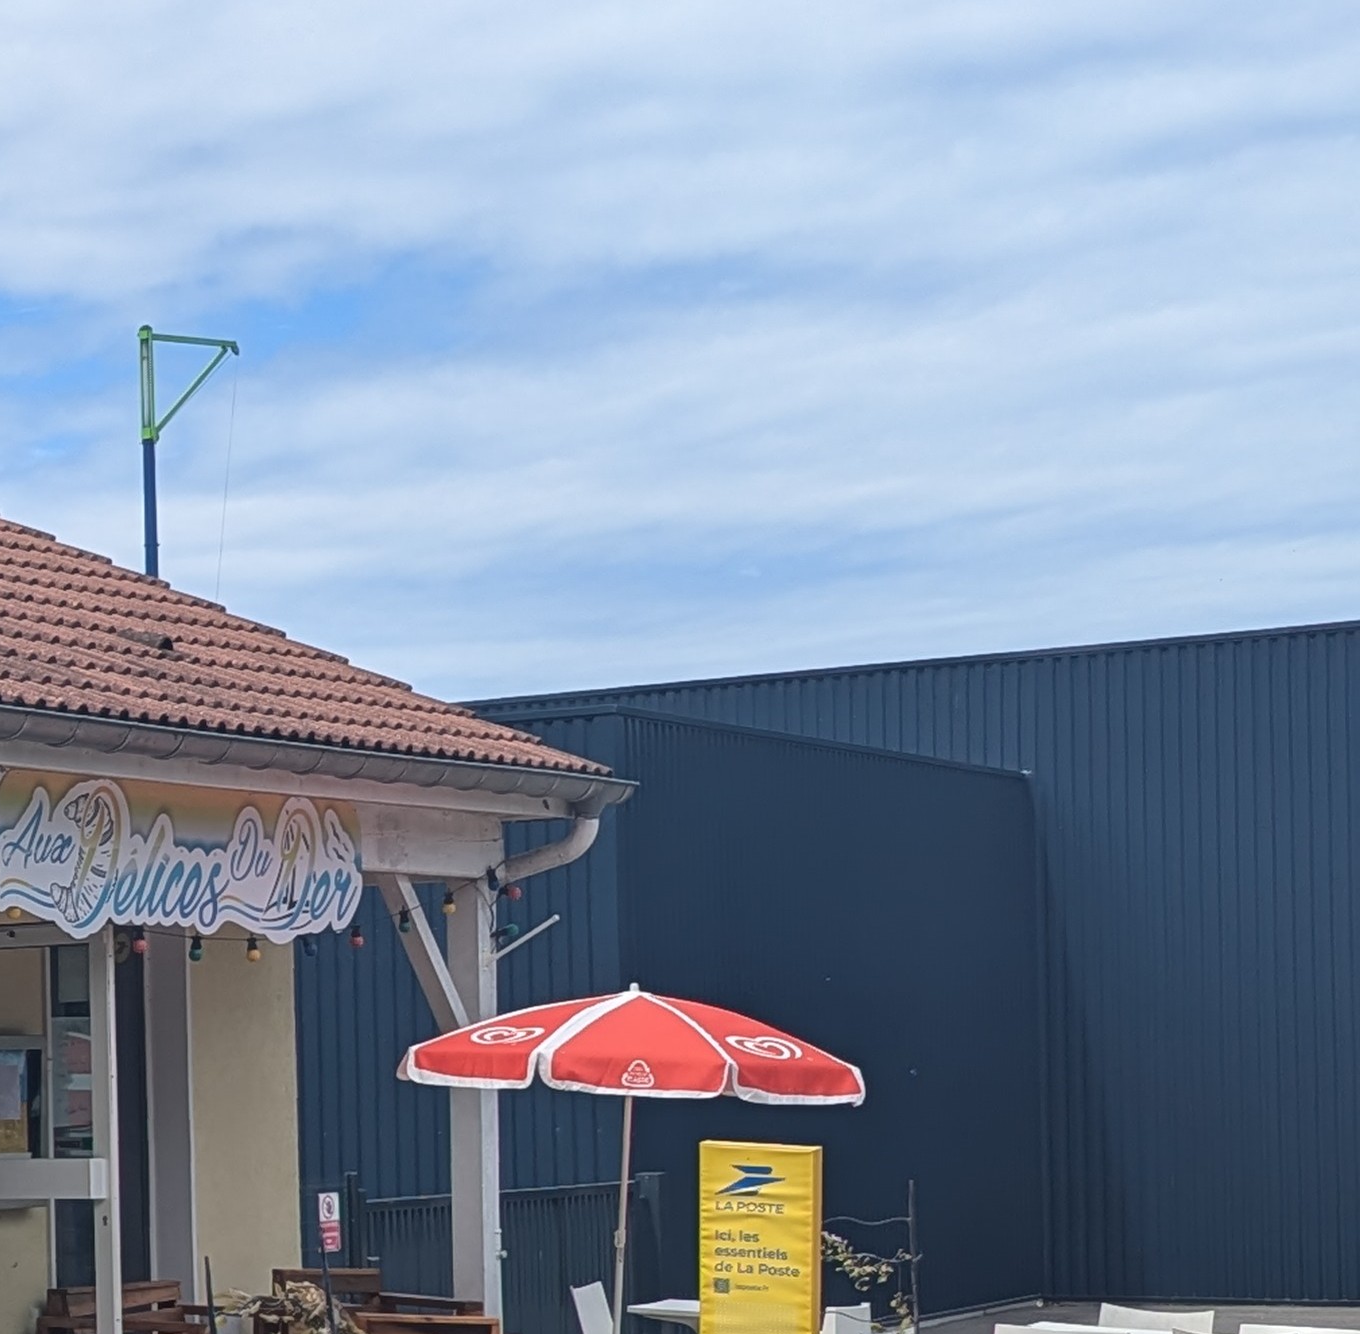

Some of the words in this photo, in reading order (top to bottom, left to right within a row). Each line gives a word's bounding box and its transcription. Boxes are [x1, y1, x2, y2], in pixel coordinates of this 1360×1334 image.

[2, 800, 76, 869] Aux
[230, 818, 274, 881] Du
[260, 808, 358, 931] Der
[715, 1200, 734, 1212] LA
[736, 1201, 785, 1215] POSTE
[739, 1229, 760, 1243] les
[714, 1247, 788, 1261] essentiels
[714, 1260, 734, 1273] de
[737, 1262, 754, 1274] La
[758, 1263, 801, 1278] Poste
